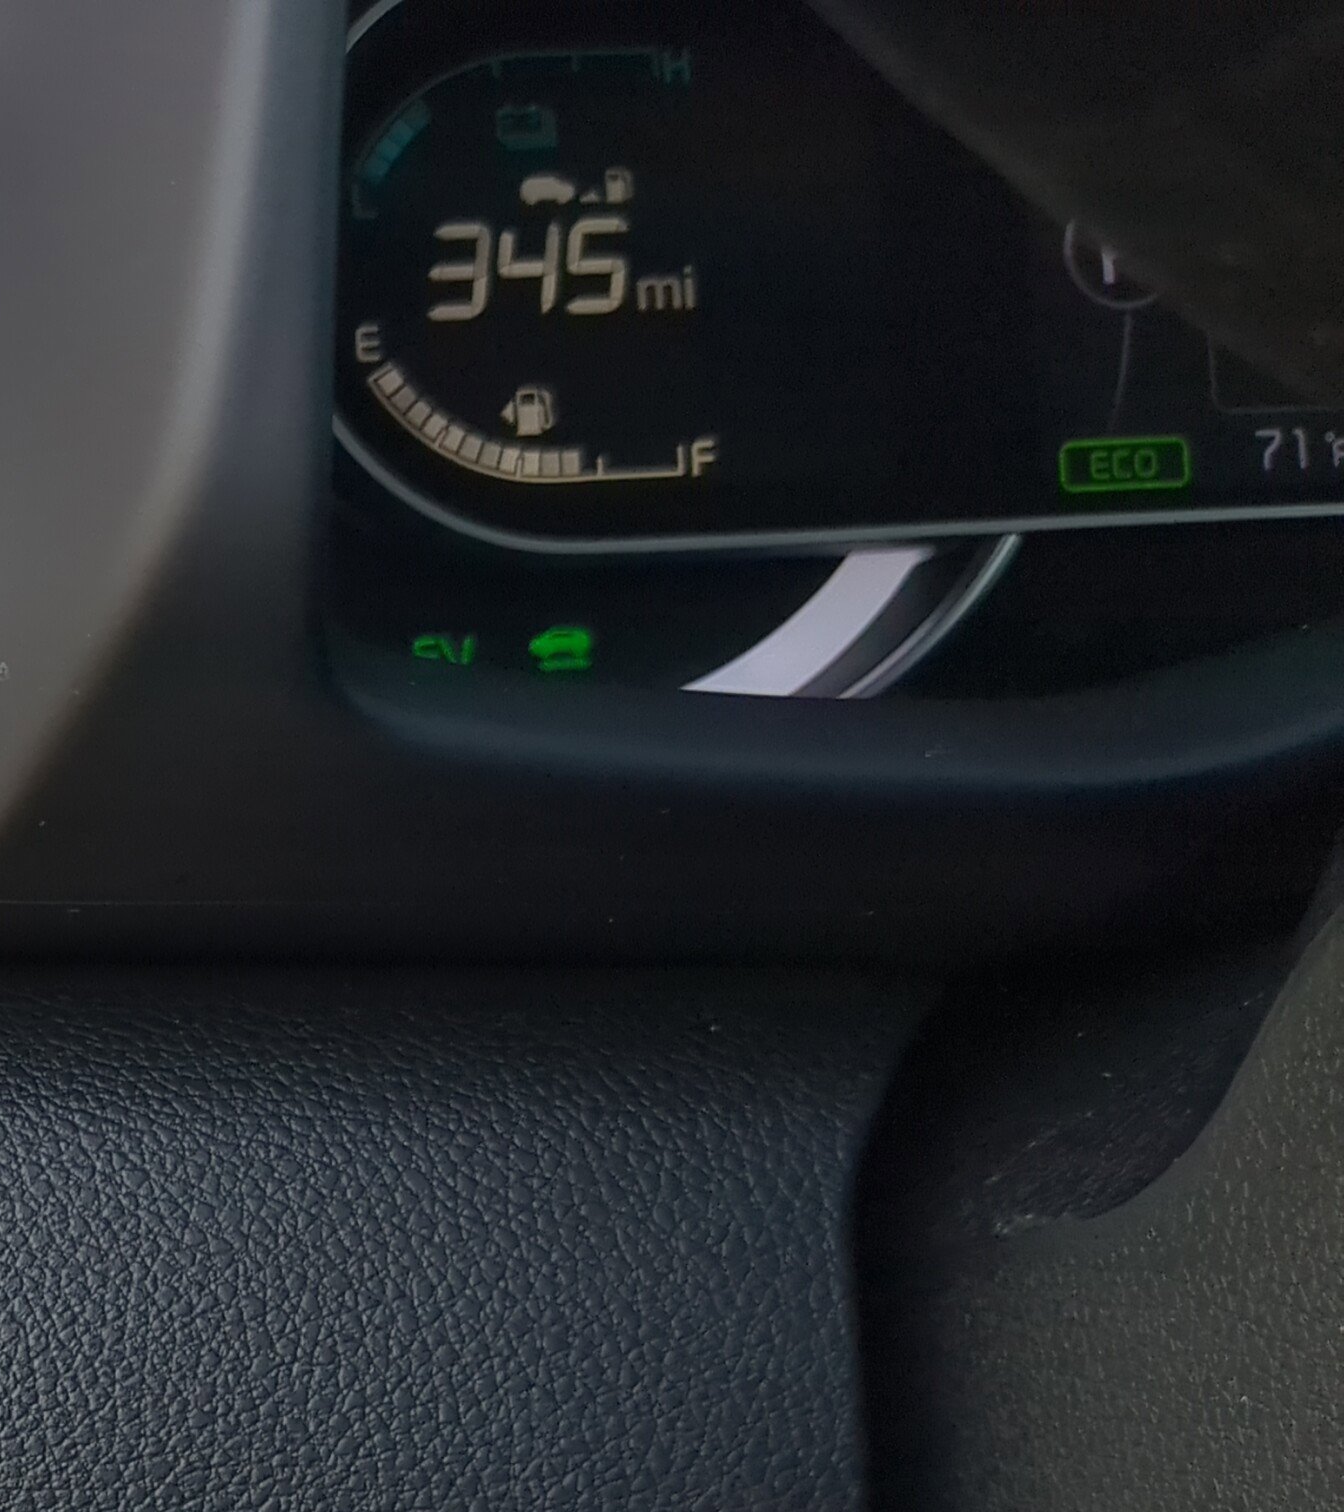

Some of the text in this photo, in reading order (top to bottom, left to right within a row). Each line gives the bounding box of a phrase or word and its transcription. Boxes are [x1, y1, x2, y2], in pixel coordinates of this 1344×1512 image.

[426, 217, 698, 321] 345 mi
[354, 323, 382, 363] E
[691, 437, 719, 478] F
[1089, 447, 1158, 480] ECO
